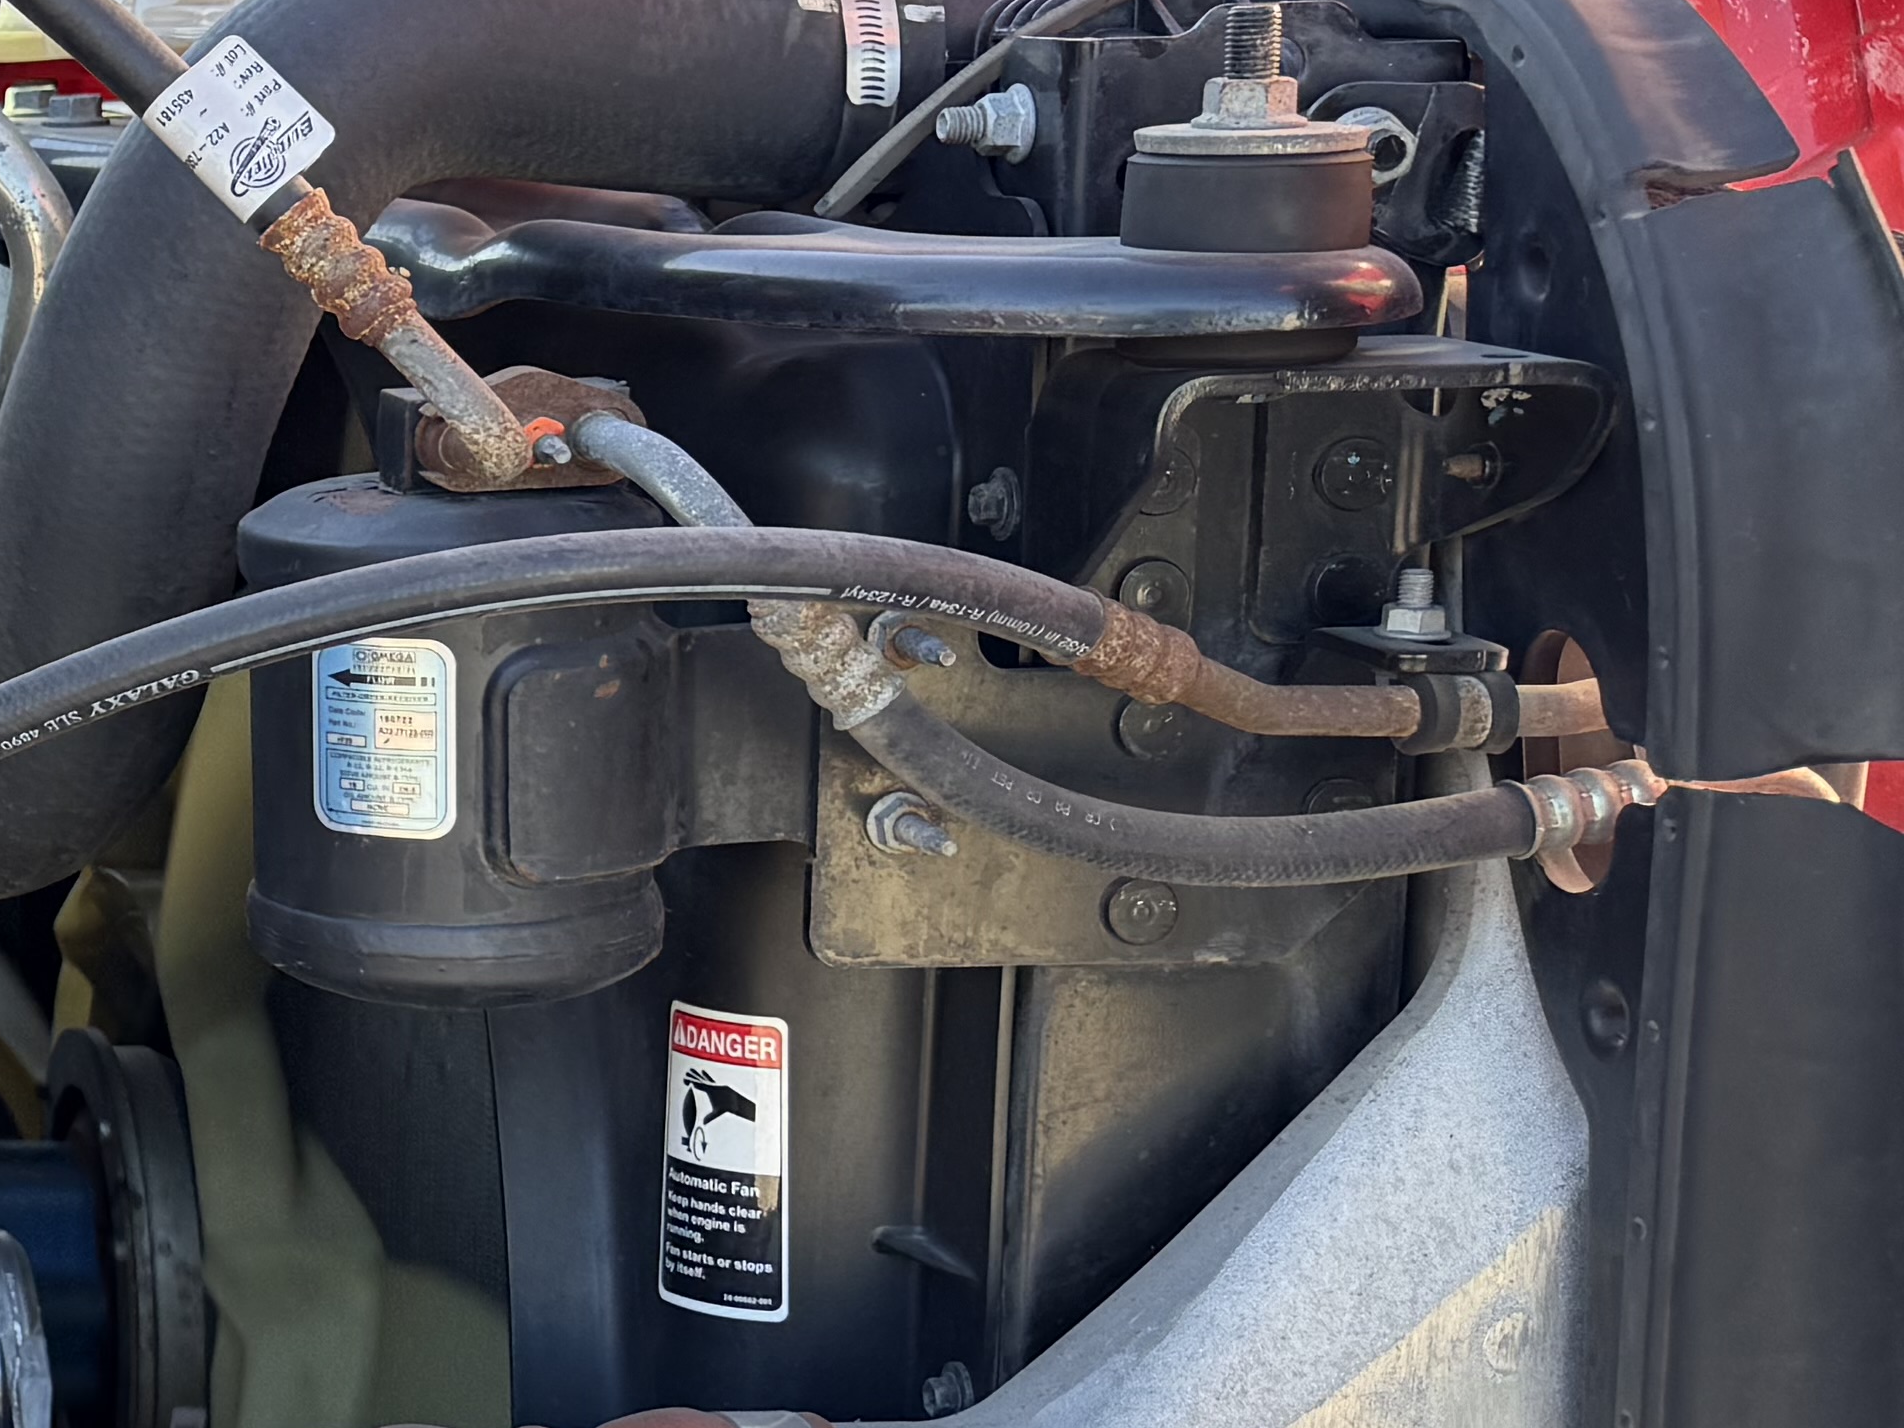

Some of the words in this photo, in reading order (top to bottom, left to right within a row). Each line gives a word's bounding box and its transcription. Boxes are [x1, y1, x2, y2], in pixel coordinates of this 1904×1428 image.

[225, 44, 246, 66] Lot
[254, 79, 282, 106] Part
[156, 89, 194, 127] 435181
[371, 652, 412, 662] OMEGA
[90, 669, 200, 717] GALAXY
[686, 1028, 777, 1062] DANGER
[669, 1167, 727, 1193] Automatic
[731, 1181, 760, 1198] Fan
[668, 1190, 688, 1207] Keep
[691, 1197, 725, 1215] hands
[729, 1206, 762, 1219] clear
[668, 1207, 689, 1222] when
[691, 1215, 730, 1231] engine
[734, 1221, 745, 1233] is
[666, 1241, 680, 1256] Fan
[683, 1250, 714, 1265] starts
[717, 1258, 731, 1268] or
[734, 1260, 773, 1274] stops
[666, 1256, 675, 1272] by
